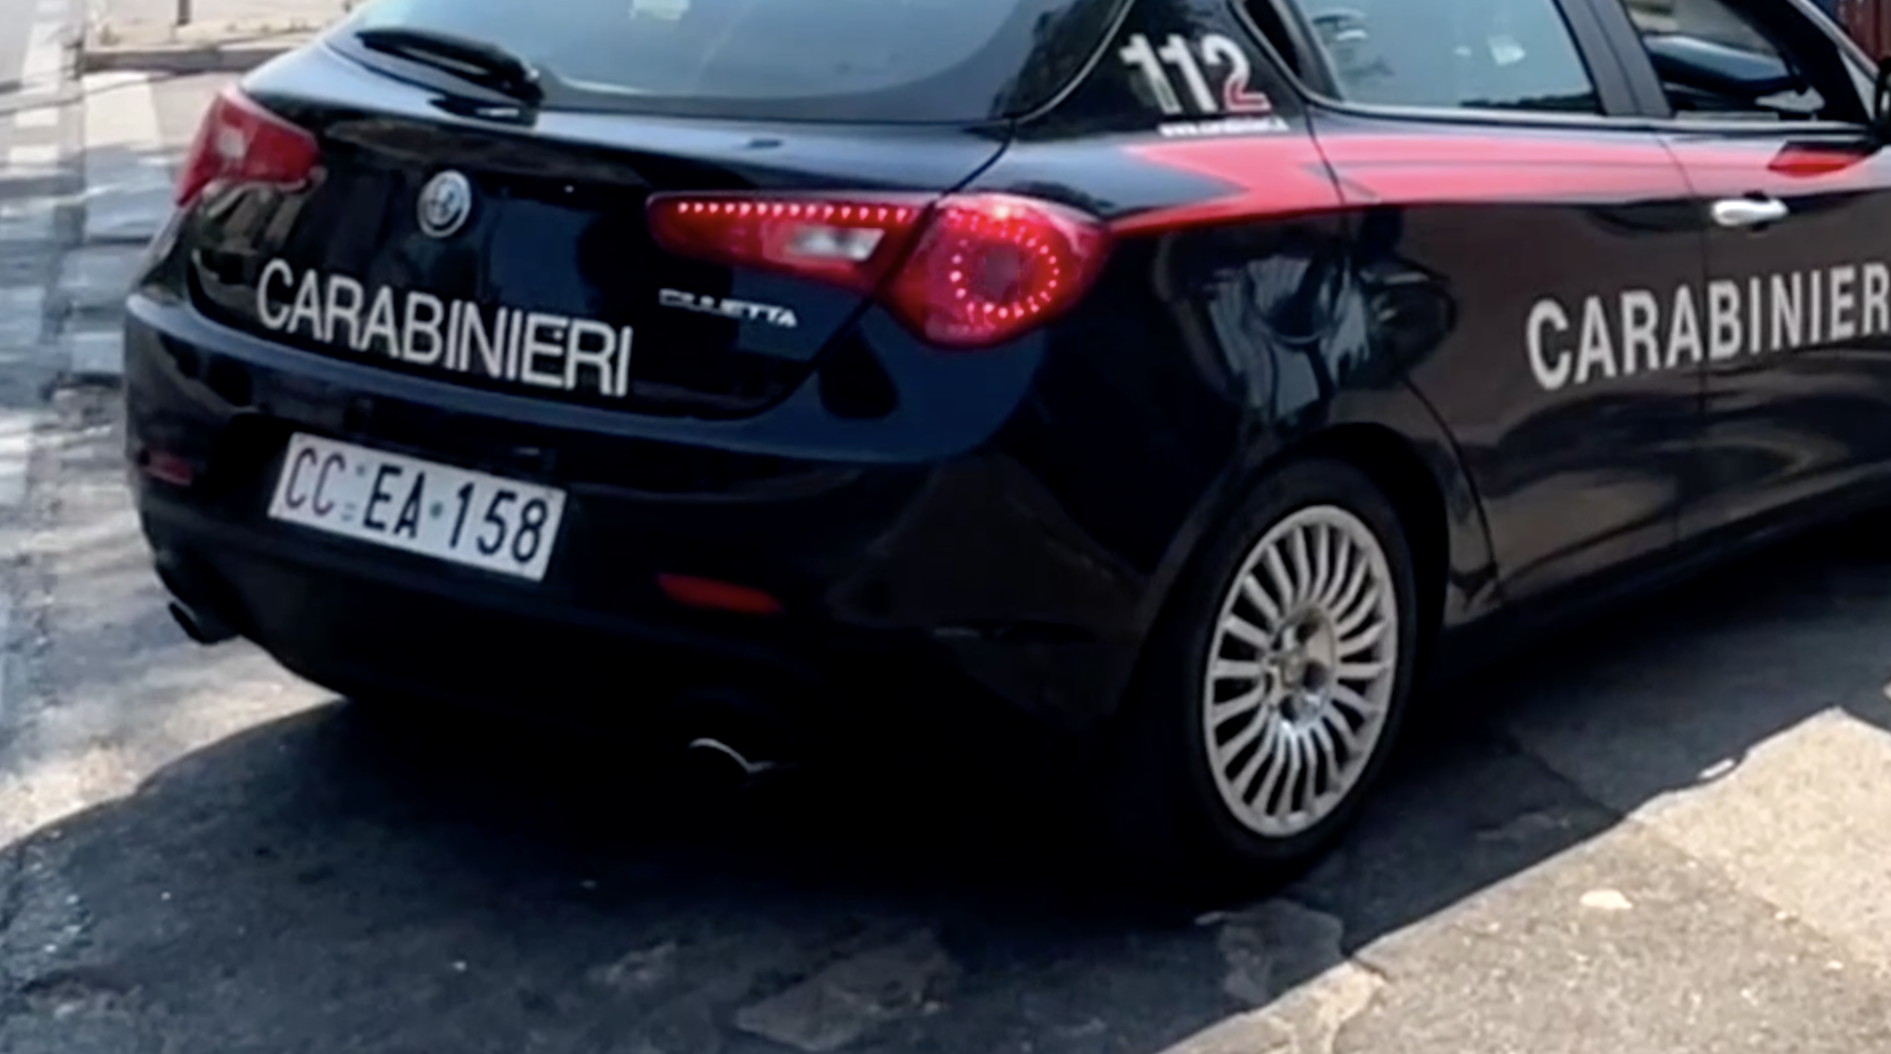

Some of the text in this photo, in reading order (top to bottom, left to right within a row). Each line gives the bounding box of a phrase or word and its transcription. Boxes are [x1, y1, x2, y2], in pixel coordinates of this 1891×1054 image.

[1118, 32, 1272, 114] 112
[257, 258, 634, 398] CARABINIERI
[284, 447, 549, 564] CC EA 158
